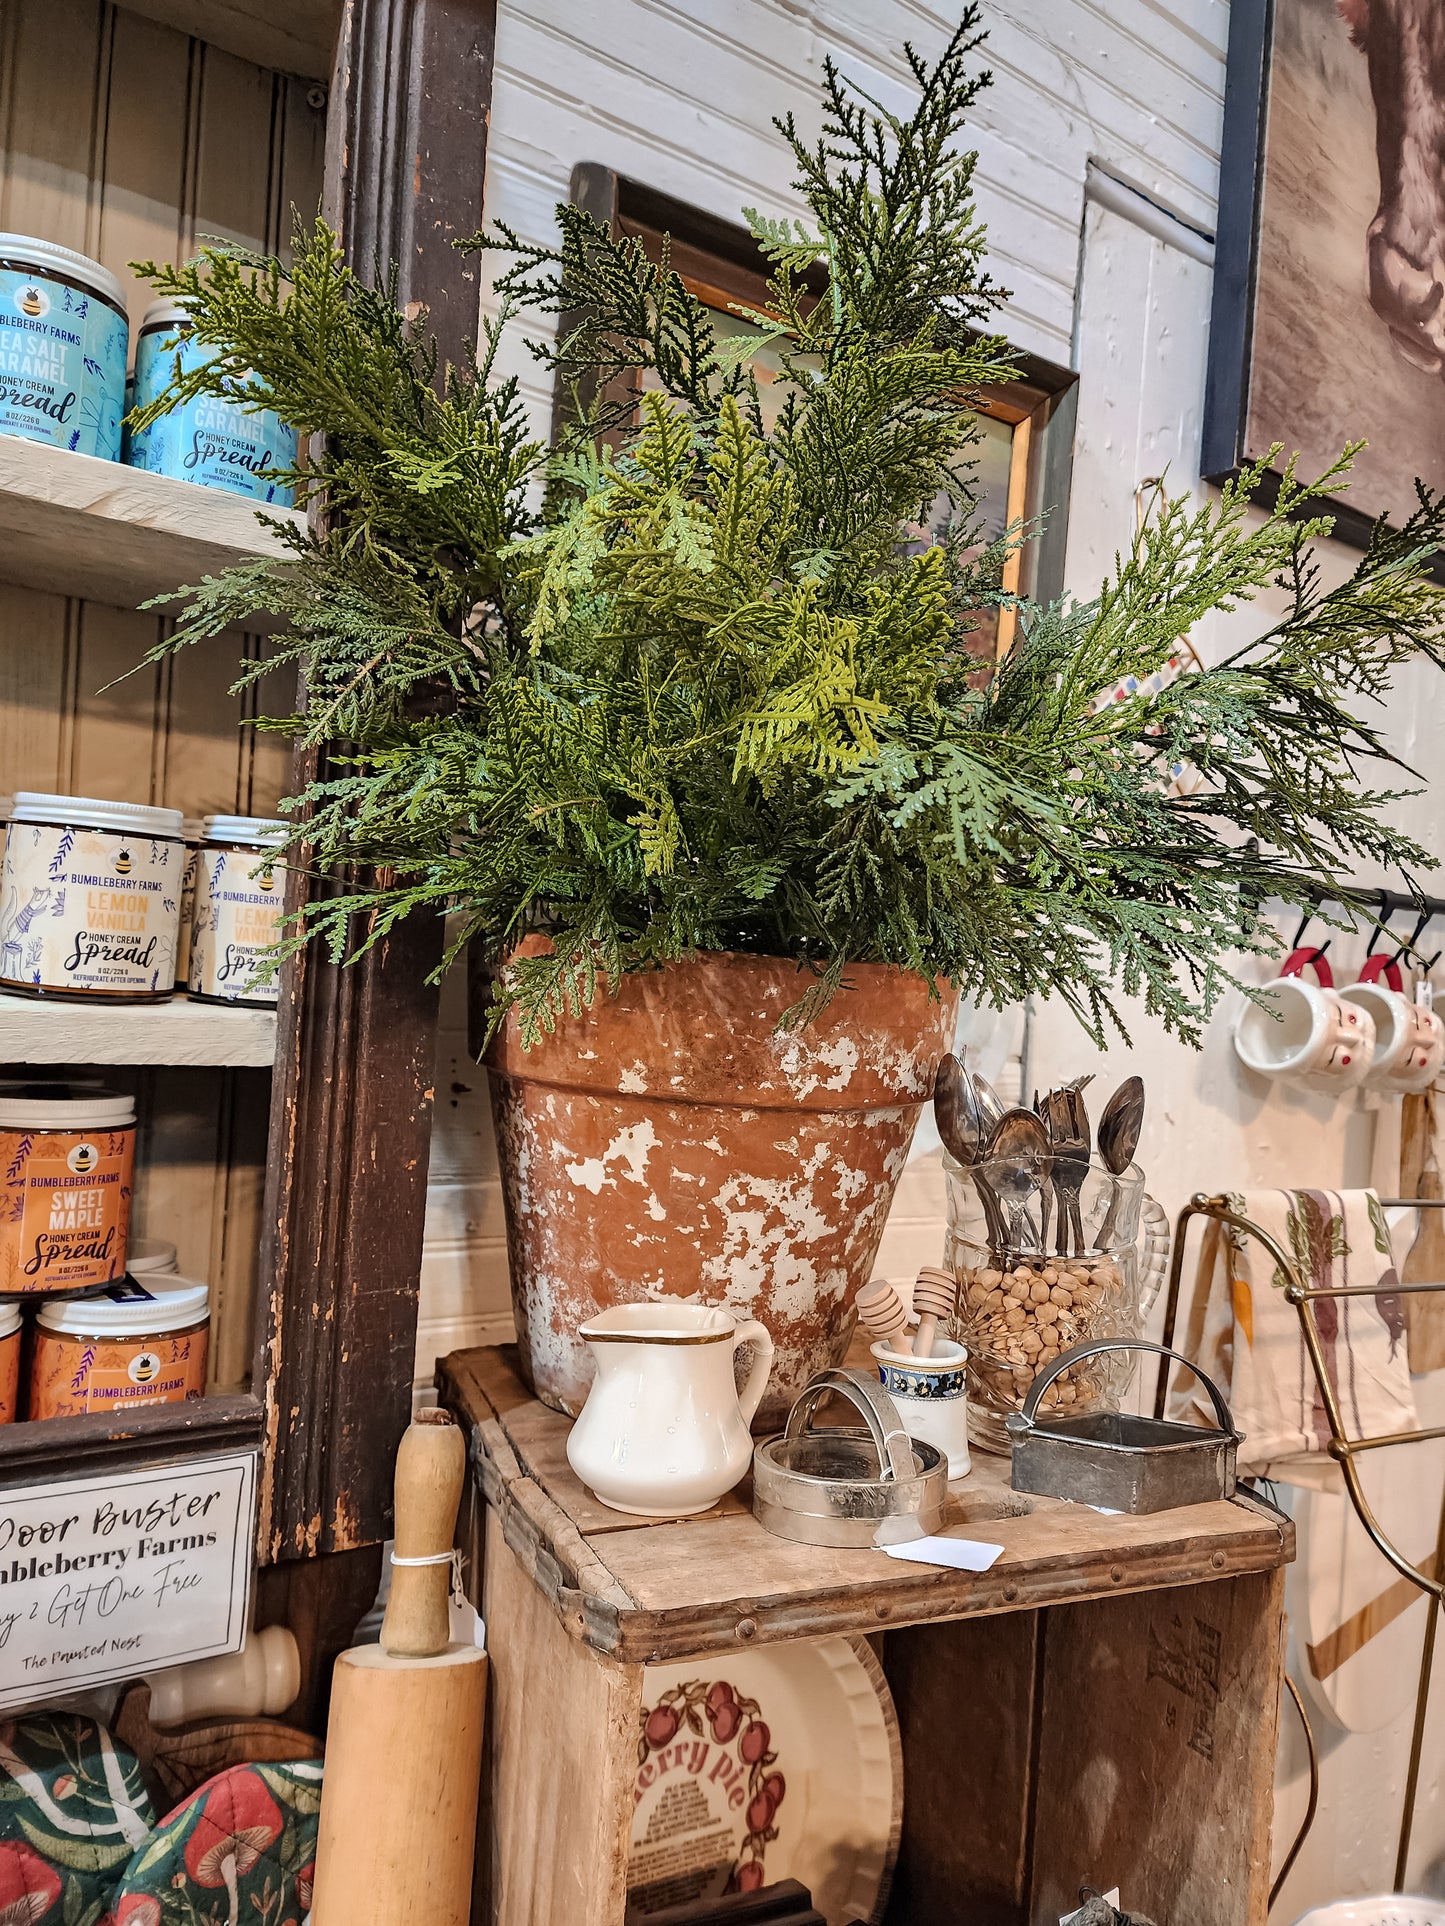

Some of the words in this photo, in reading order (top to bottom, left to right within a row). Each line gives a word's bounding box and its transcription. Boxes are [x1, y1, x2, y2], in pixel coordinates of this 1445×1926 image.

[50, 326, 81, 346] FARMS
[26, 335, 68, 364] SALT
[26, 380, 55, 395] CREAM
[194, 408, 267, 446] CARAMEL
[183, 429, 272, 480] Spread
[205, 432, 230, 445] HONEY
[231, 438, 256, 454] CREAM
[71, 873, 137, 890] BUMBLEBERRY
[139, 881, 163, 891] FARMS
[87, 890, 149, 914] LEMON
[223, 891, 280, 906] BUMBLEBERRY
[86, 911, 146, 932] VANILLA
[89, 933, 115, 943] HONEY
[116, 935, 142, 945] CREAM
[64, 931, 158, 971] Spread
[30, 1175, 97, 1188] BUMBLEBERRY
[98, 1172, 120, 1185] FARMS
[51, 1188, 105, 1211] SWEET
[48, 1208, 104, 1231] MAPLE
[49, 1233, 76, 1244] HONEY
[77, 1230, 101, 1241] CREAM
[24, 1226, 116, 1276] Spread
[93, 1384, 158, 1398] BUMBLEBERRY
[160, 1377, 185, 1392] FARMS
[93, 1491, 221, 1537] Buster
[137, 1531, 217, 1559] Farms
[29, 1601, 38, 1619] 2
[47, 1583, 102, 1629] Get
[98, 1576, 145, 1618] One
[153, 1559, 203, 1608] Free
[22, 1654, 48, 1670] The
[111, 1634, 143, 1652] Nest
[635, 1741, 710, 1804] erry
[708, 1751, 746, 1812] pie
